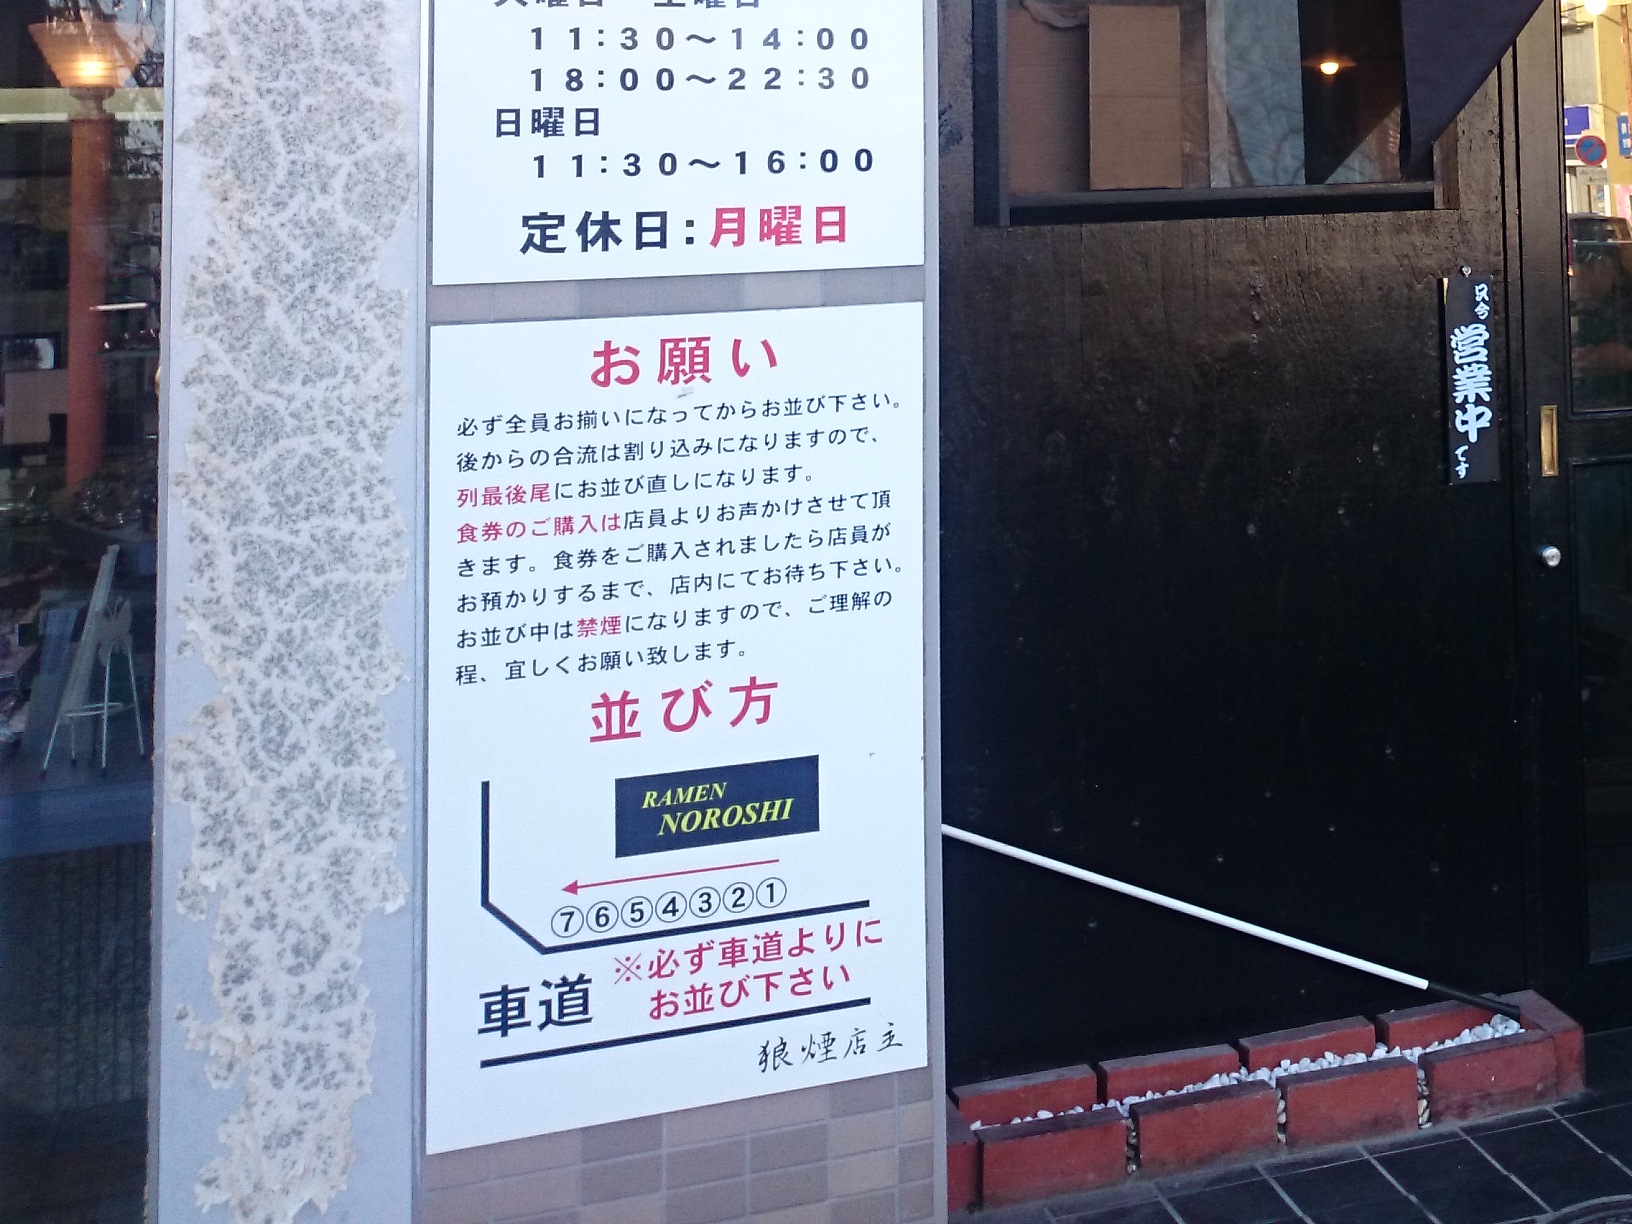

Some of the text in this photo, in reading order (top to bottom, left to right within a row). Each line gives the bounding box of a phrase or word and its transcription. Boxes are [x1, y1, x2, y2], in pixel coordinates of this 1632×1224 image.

[495, 107, 601, 139] 日曜日
[590, 336, 779, 388] お願い
[457, 426, 879, 473] 後からの合流は割り込みになりますので、
[457, 464, 813, 508] 列最後尾にお並び直しになります。
[457, 490, 891, 545] 食券のご購入は店員よりお声かけさせて頂
[457, 525, 891, 578] きます。食券をご購入されましたら店員が
[457, 558, 902, 613] お預かりするまで、店内にてお待ち下さい。
[457, 590, 892, 649] お並び中は禁煙になりますので、ご理解の
[456, 638, 747, 686] 程、宜しくお願い致します。
[589, 676, 778, 743] 並び方
[642, 782, 727, 809] RAMEN
[657, 797, 795, 836] NOROSHI
[478, 972, 593, 1038] 車道
[648, 963, 851, 1020] お並び下さい
